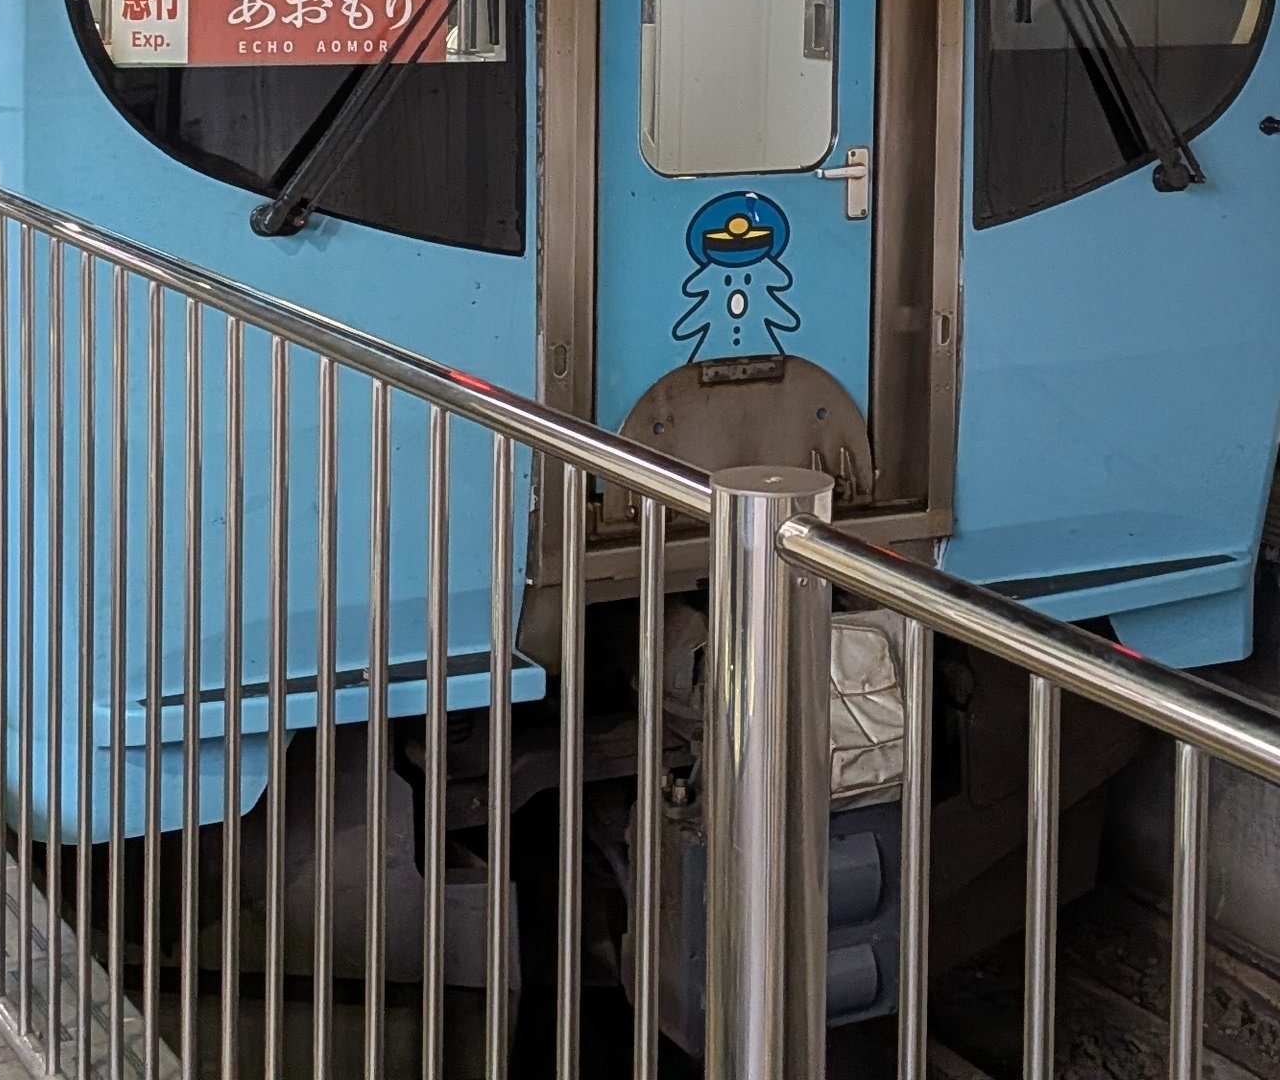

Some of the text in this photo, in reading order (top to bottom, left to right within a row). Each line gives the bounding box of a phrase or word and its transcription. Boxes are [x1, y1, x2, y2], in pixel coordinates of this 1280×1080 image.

[131, 30, 171, 52] Exp.
[238, 39, 390, 54] ECHO AOMOR
